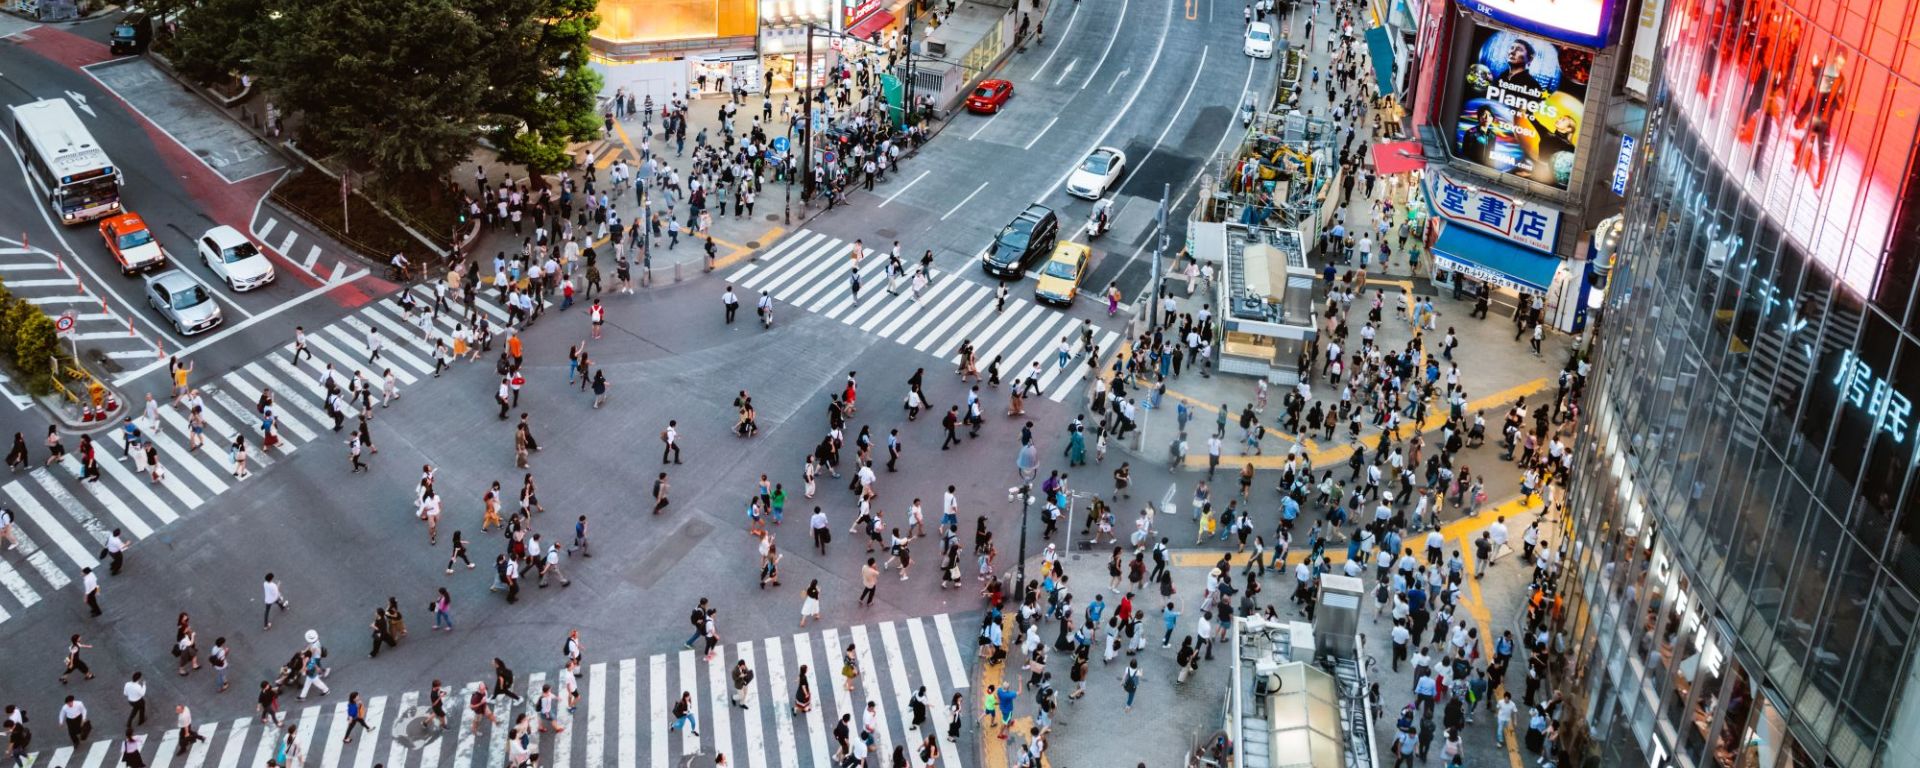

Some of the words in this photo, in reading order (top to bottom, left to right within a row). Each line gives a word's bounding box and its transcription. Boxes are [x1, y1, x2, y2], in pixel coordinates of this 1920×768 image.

[1477, 3, 1493, 16] DHC
[1498, 79, 1541, 98] teamLab
[1486, 86, 1557, 118] Planets
[1433, 172, 1548, 241] 堂書店
